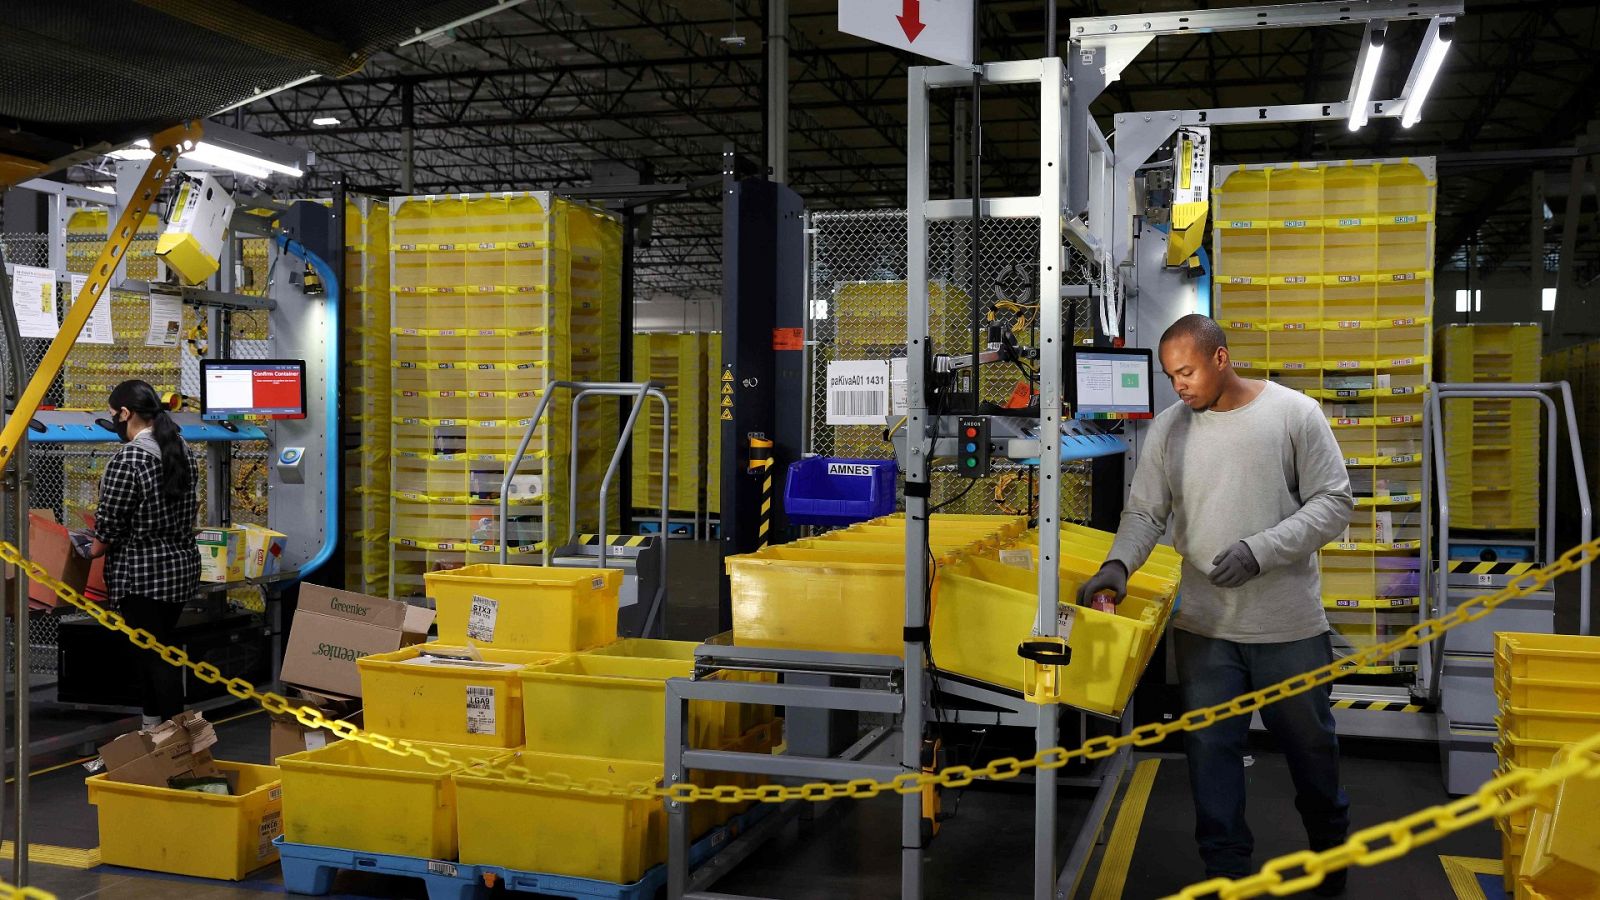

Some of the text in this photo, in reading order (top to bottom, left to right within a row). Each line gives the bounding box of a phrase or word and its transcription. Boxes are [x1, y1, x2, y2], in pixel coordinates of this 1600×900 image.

[831, 375, 884, 388] paKivaA01 1431
[330, 596, 368, 617] Greenies
[318, 642, 369, 662] reenies
